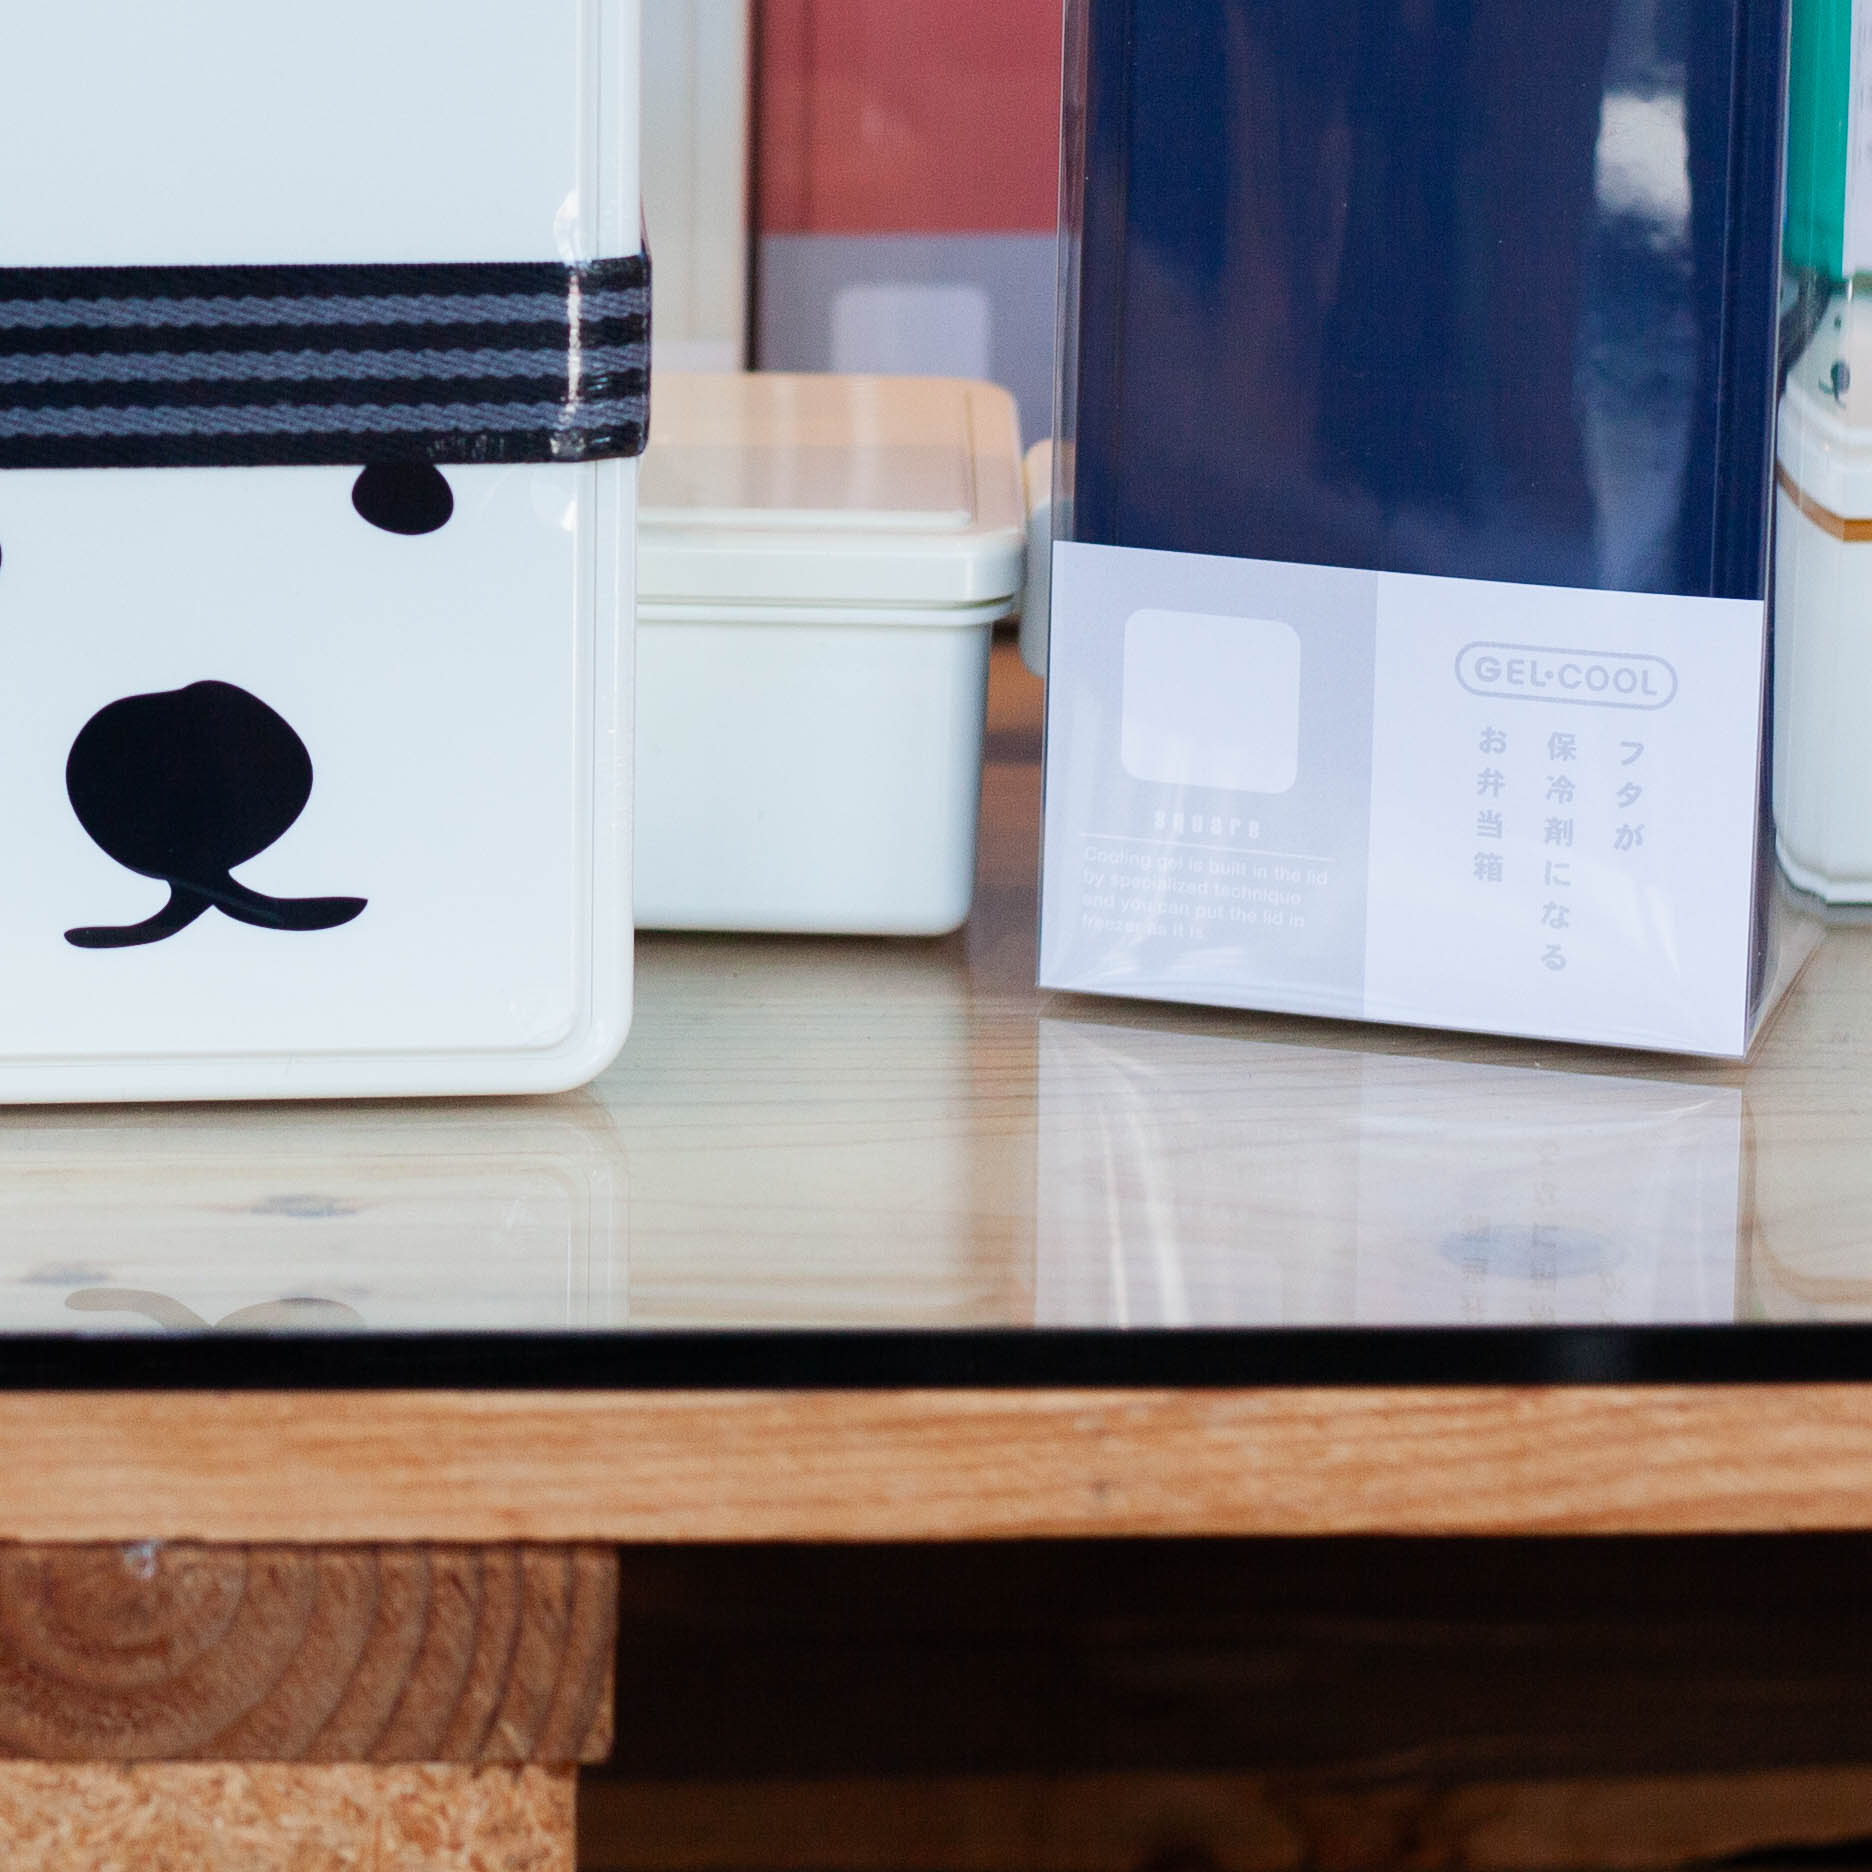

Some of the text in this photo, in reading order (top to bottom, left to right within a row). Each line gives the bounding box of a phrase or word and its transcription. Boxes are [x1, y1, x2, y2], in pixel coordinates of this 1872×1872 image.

[1472, 725, 1508, 884] お弁当箱
[1540, 729, 1578, 972] 保冷剤になる
[1613, 739, 1646, 852] フタが
[1196, 904, 1224, 922] put
[1230, 907, 1257, 924] the
[1253, 863, 1268, 880] in
[1275, 865, 1301, 883] the
